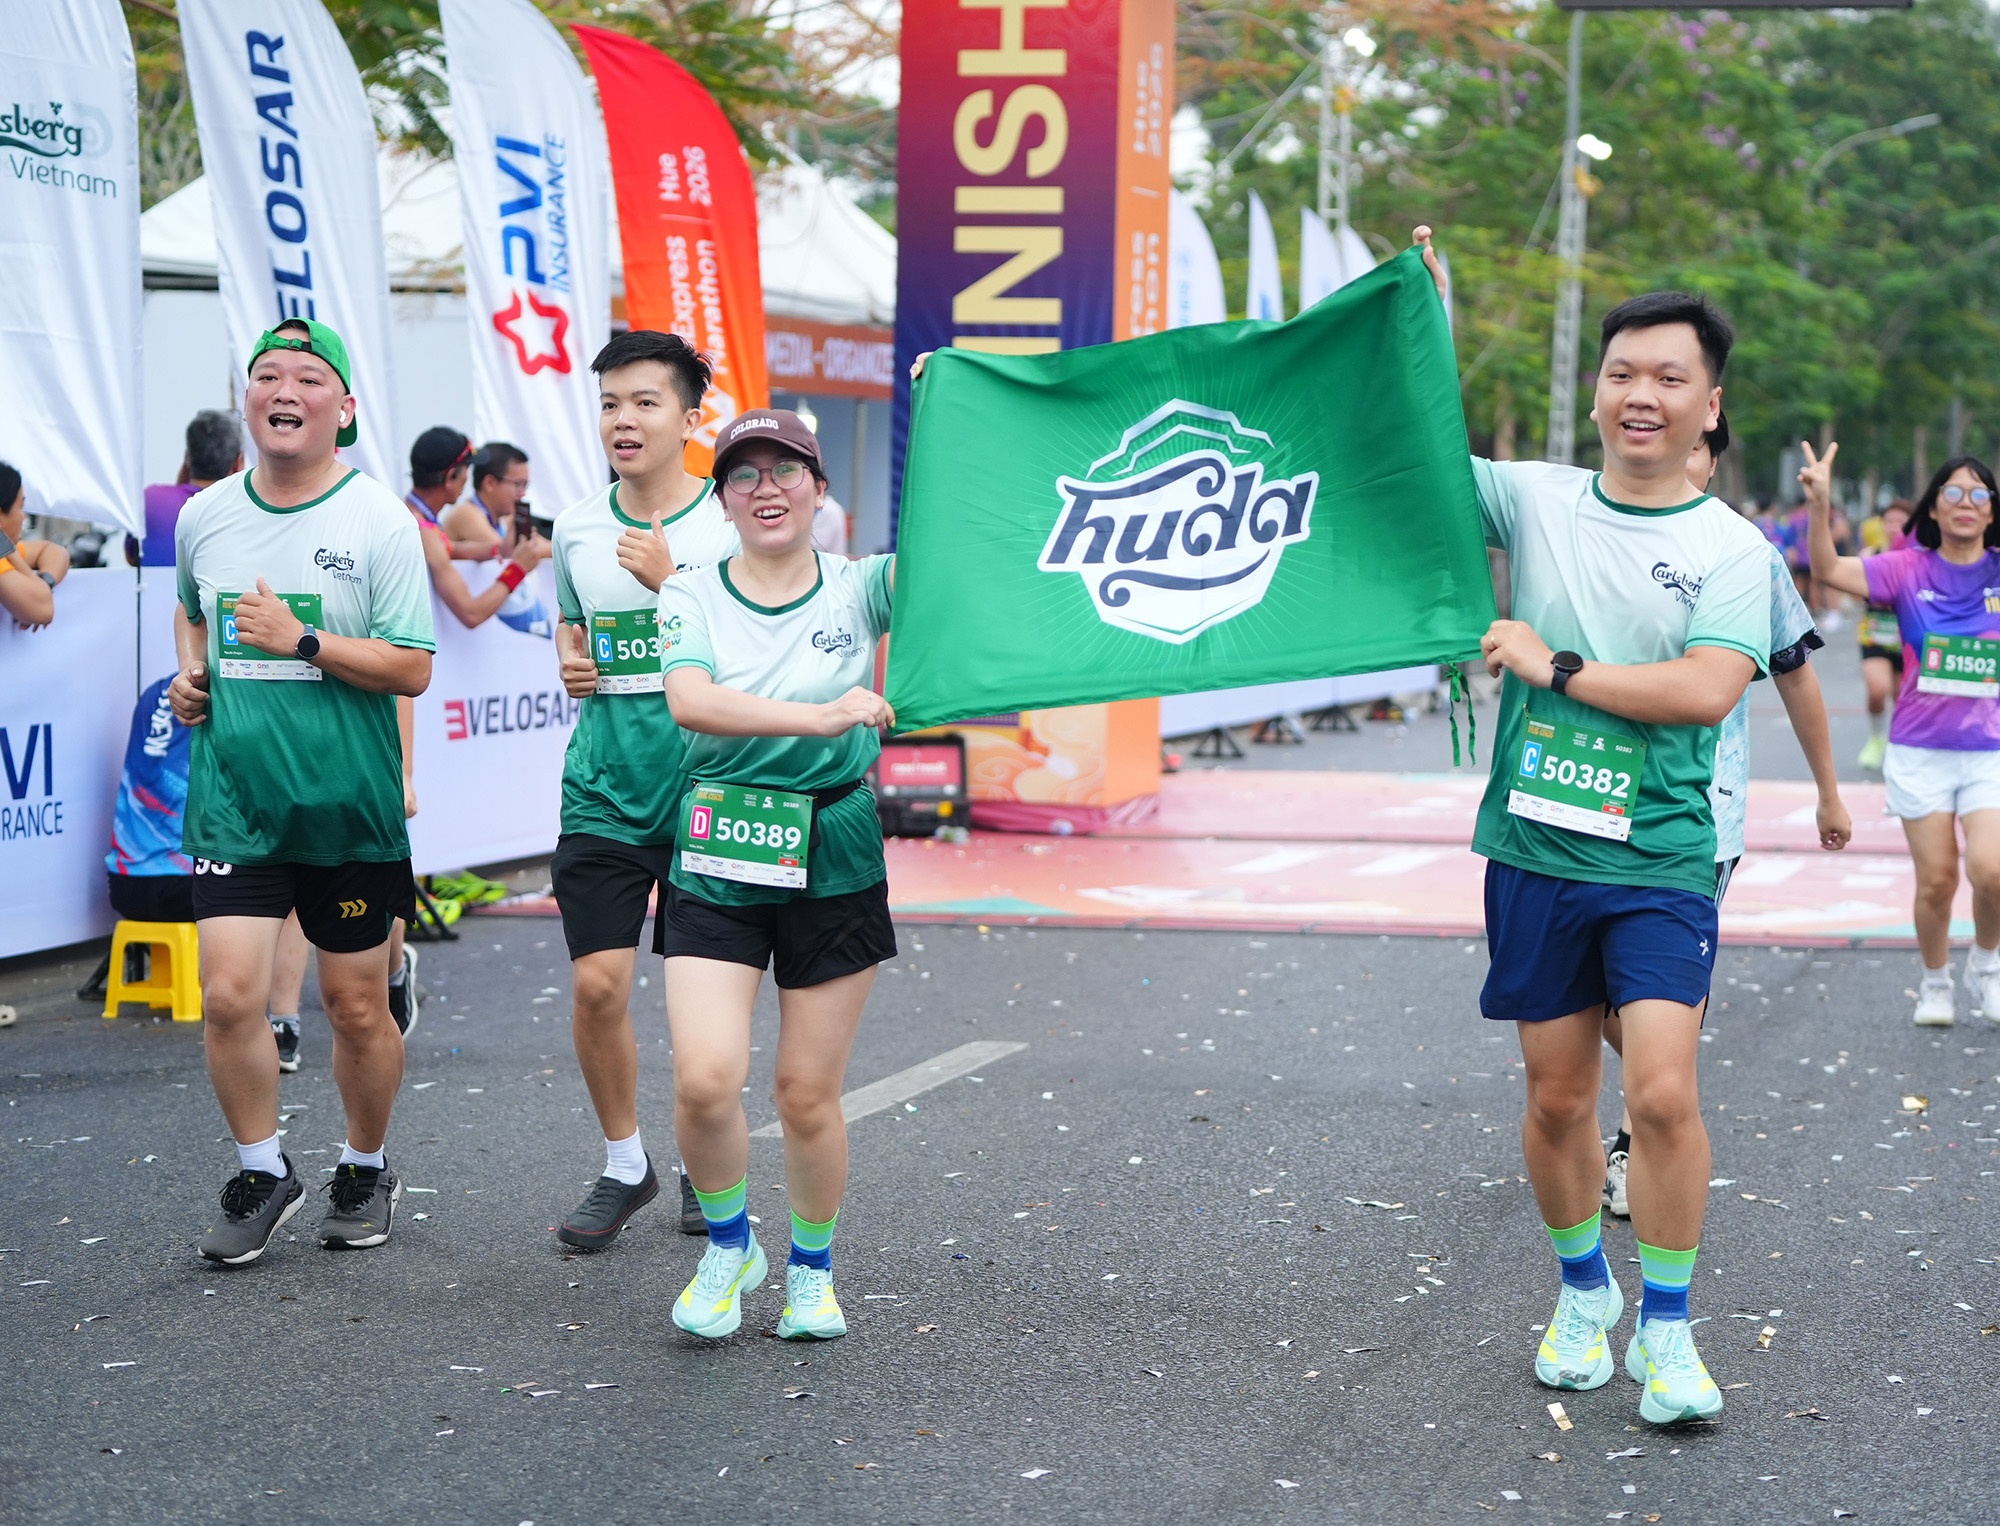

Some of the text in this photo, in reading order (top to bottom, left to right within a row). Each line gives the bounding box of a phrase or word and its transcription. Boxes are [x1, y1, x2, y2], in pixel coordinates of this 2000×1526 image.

[9, 153, 117, 198] Vietnam
[658, 153, 682, 201] Hue
[682, 145, 712, 207] 2026
[495, 136, 546, 285] PVI
[544, 131, 570, 293] INSURANCE
[730, 417, 779, 440] COLORADO
[1045, 457, 1315, 565] huda
[313, 547, 355, 571] Carlsberg
[225, 619, 237, 641] C
[598, 636, 661, 661] C 503
[1944, 654, 1997, 675] 51502
[1523, 747, 1631, 799] C 50382
[2, 802, 63, 841] RANCE
[693, 810, 802, 851] D 50389
